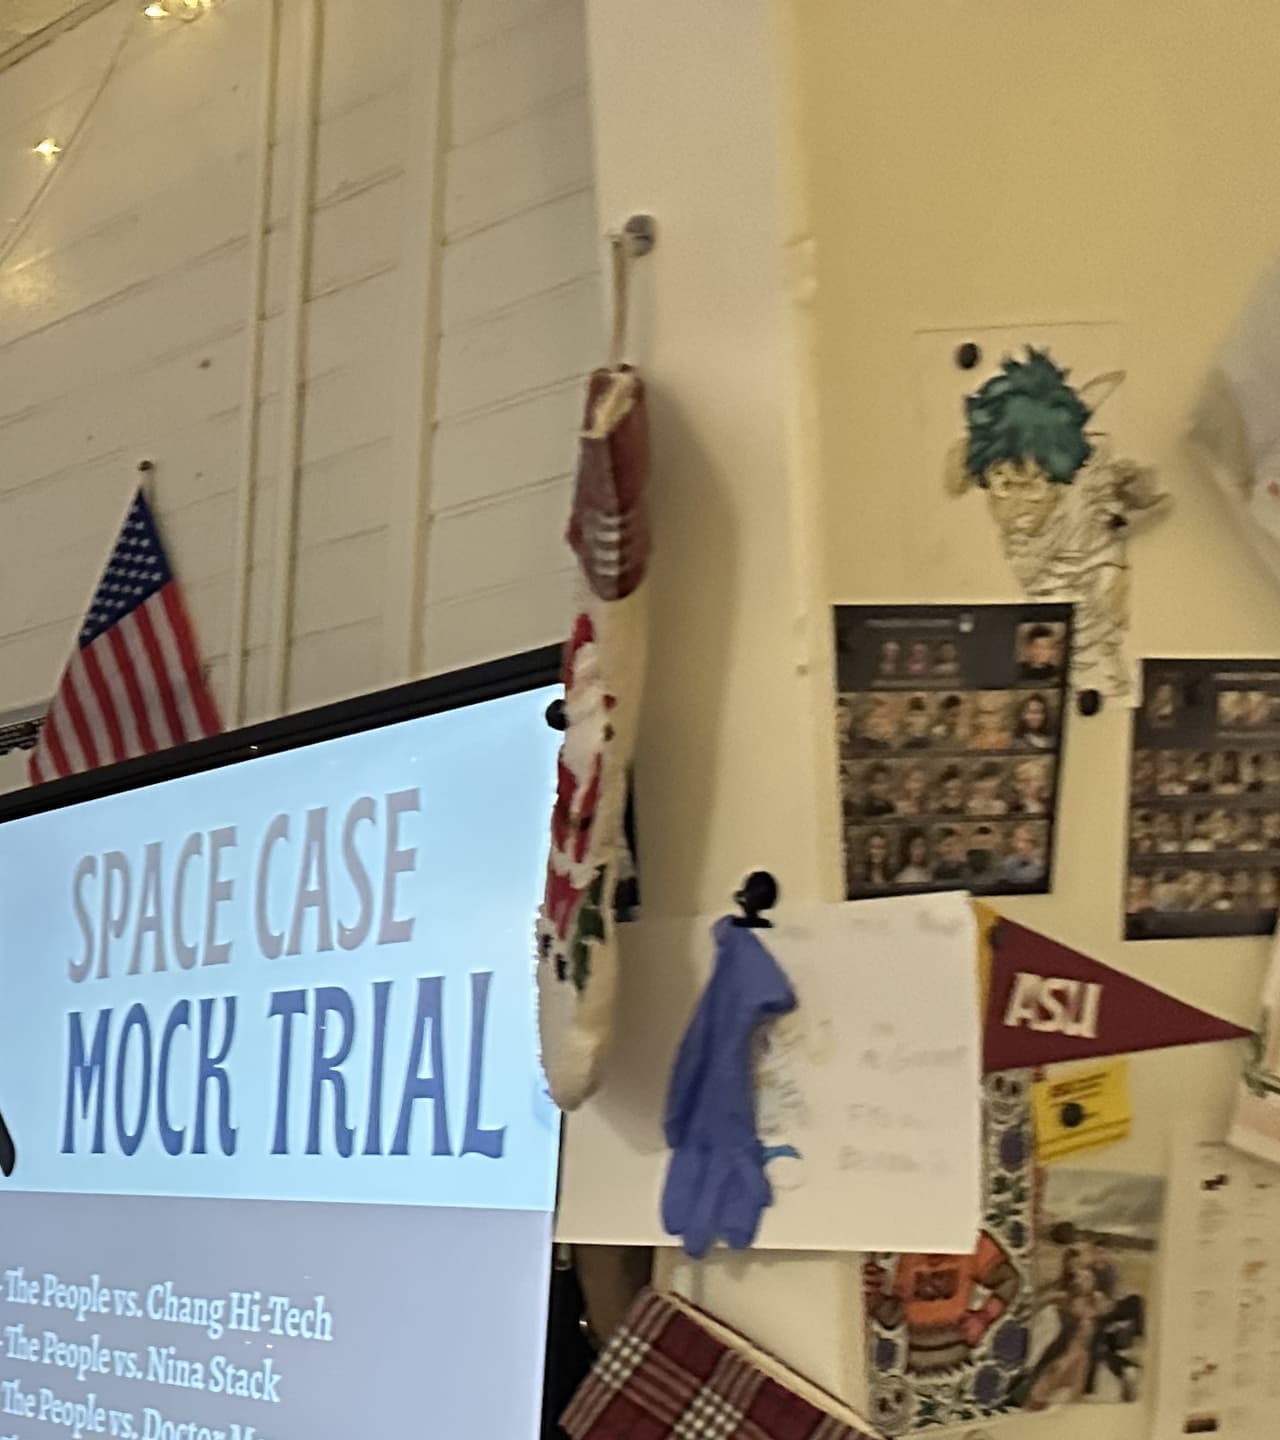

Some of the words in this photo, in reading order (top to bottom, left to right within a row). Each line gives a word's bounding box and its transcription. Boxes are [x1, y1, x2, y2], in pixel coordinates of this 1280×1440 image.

[68, 824, 239, 983] SPACE
[254, 787, 421, 960] CASE
[1003, 971, 1104, 1039] ASU
[60, 995, 239, 1157] MOCK
[268, 971, 509, 1160] TRIAL
[4, 1268, 38, 1304] The
[42, 1273, 110, 1322] People
[114, 1296, 142, 1319] vs.
[146, 1281, 225, 1340] Chang
[229, 1291, 334, 1342] Hi-Tech
[3, 1324, 38, 1363] The
[41, 1330, 110, 1381] People
[113, 1354, 142, 1380] vs.
[145, 1346, 205, 1392] Nina
[208, 1355, 282, 1403] Stack
[0, 1378, 36, 1420] The
[38, 1387, 105, 1440] People
[108, 1413, 139, 1440] vs.
